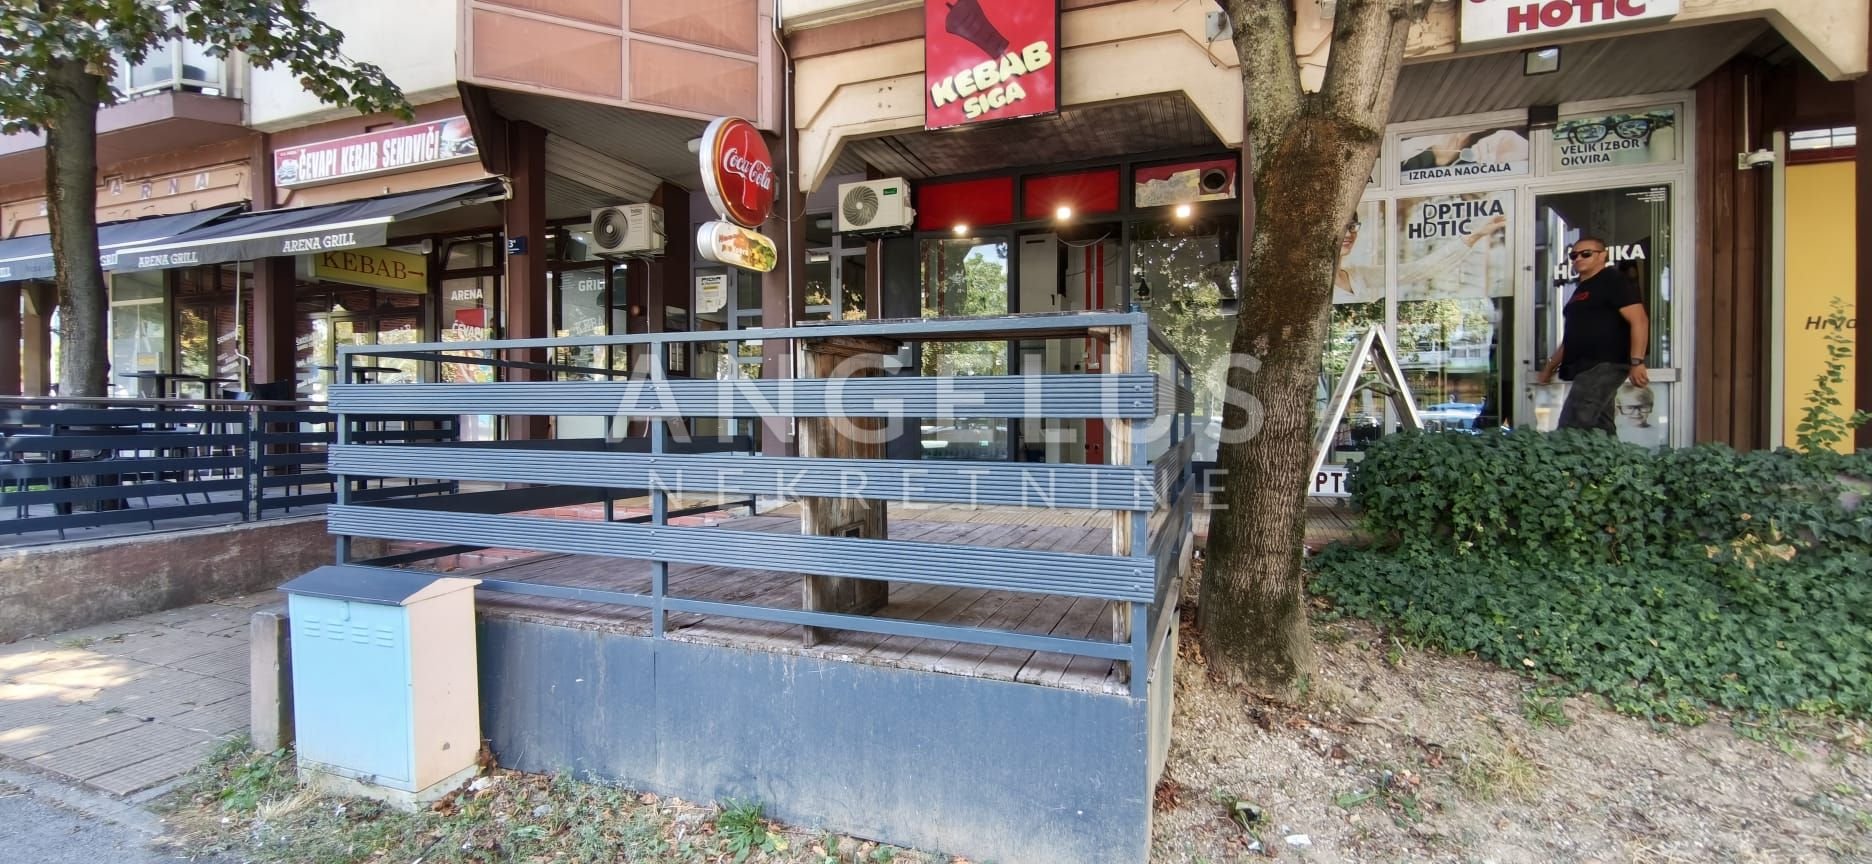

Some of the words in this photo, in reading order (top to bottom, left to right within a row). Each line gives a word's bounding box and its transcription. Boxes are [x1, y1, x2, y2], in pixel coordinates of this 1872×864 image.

[931, 41, 1052, 108] KEBAB
[962, 82, 1026, 119] SIGA
[299, 148, 337, 181] ČEVAPI
[341, 141, 378, 174] KEBAB
[382, 126, 440, 167] SENDVIČI
[1561, 143, 1597, 155] VELIK
[1600, 139, 1640, 152] IZBOR
[1561, 153, 1610, 166] OKVIRA
[1409, 168, 1452, 180] IZRADA
[1455, 162, 1511, 176] NAOČALA
[283, 236, 321, 253] ARENA
[323, 233, 356, 249] GRILL
[138, 254, 169, 268] ARENA
[171, 251, 199, 265] GRILL
[323, 250, 408, 280] KEBAB
[451, 289, 483, 300] ARENA
